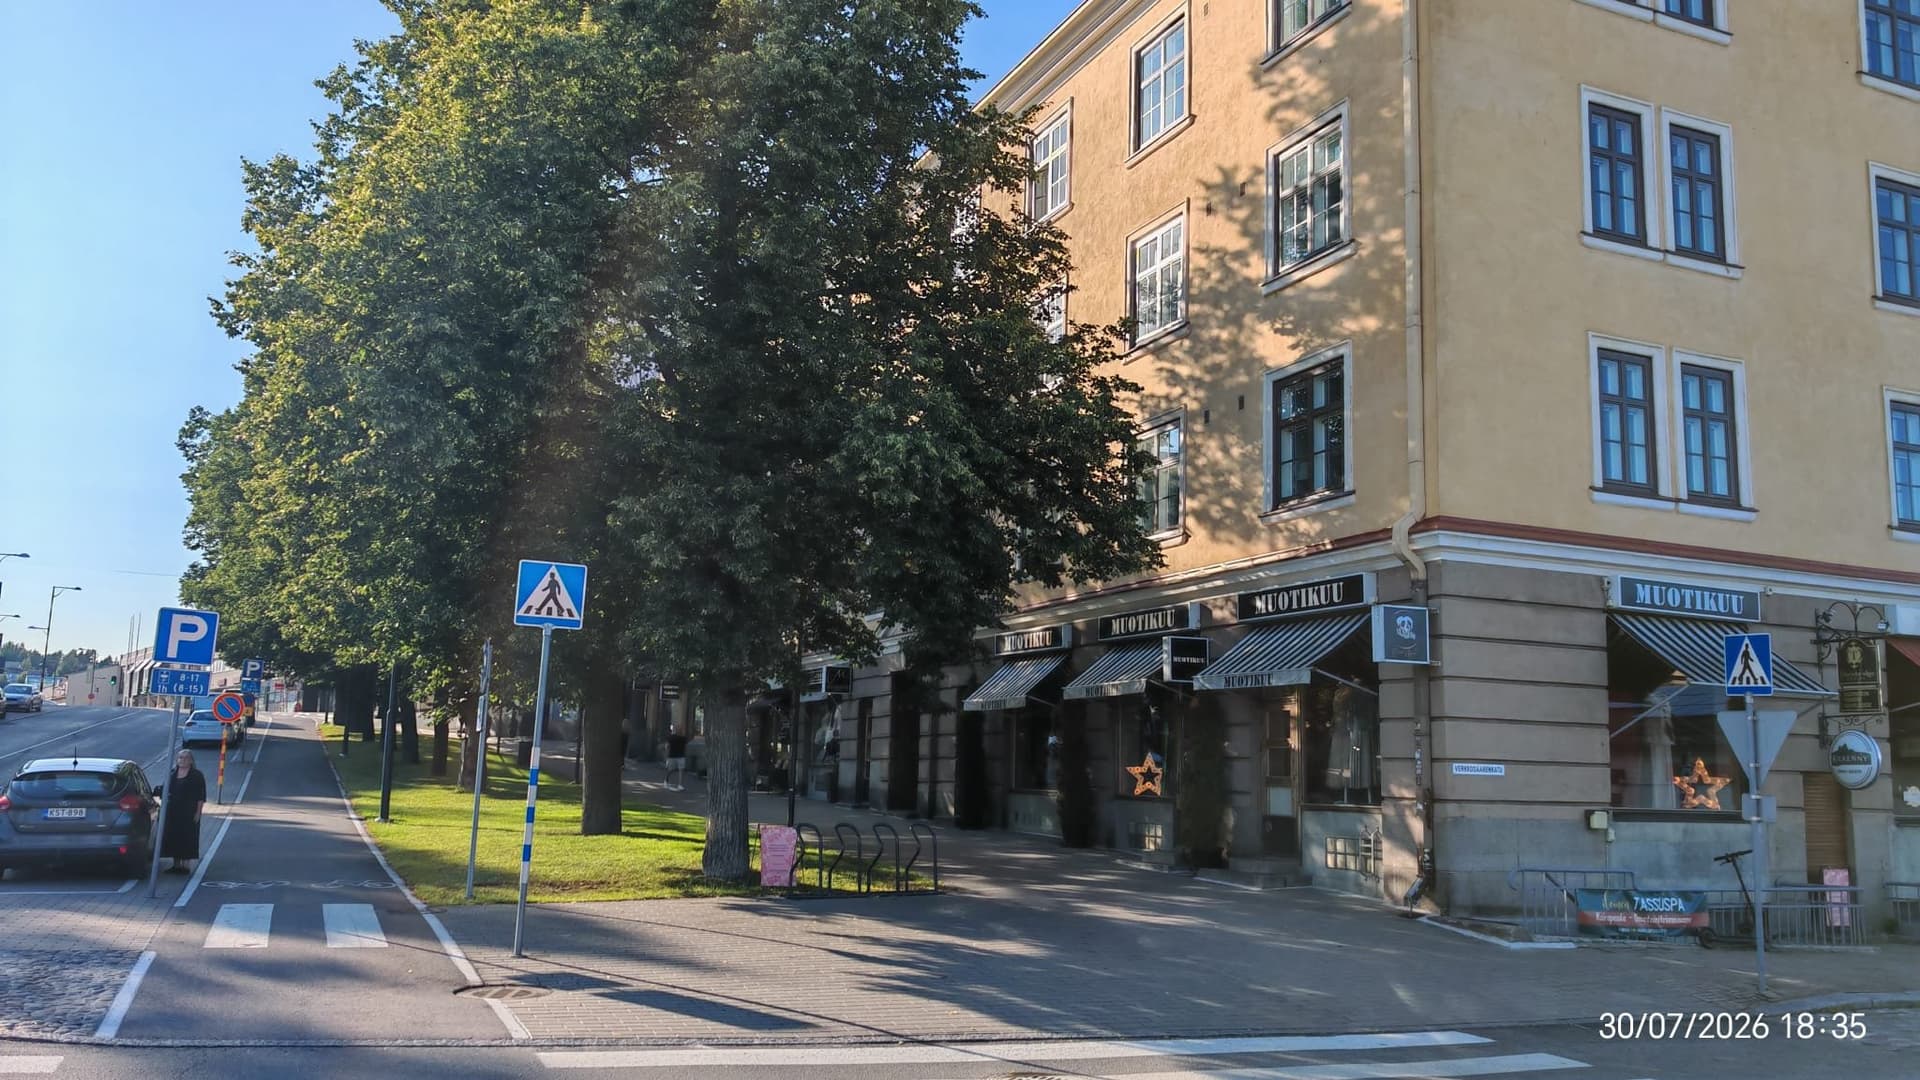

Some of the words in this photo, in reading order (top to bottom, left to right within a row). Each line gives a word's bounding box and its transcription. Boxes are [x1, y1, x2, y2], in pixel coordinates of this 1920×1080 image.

[1255, 581, 1344, 615] MUOTIKUU
[1635, 583, 1745, 615] MUOTIKUU
[166, 613, 208, 659] P
[1111, 609, 1176, 636] MUOTIKUU
[1004, 631, 1053, 651] MUOTIKUU
[246, 660, 260, 677] P
[49, 808, 84, 817] KST-898
